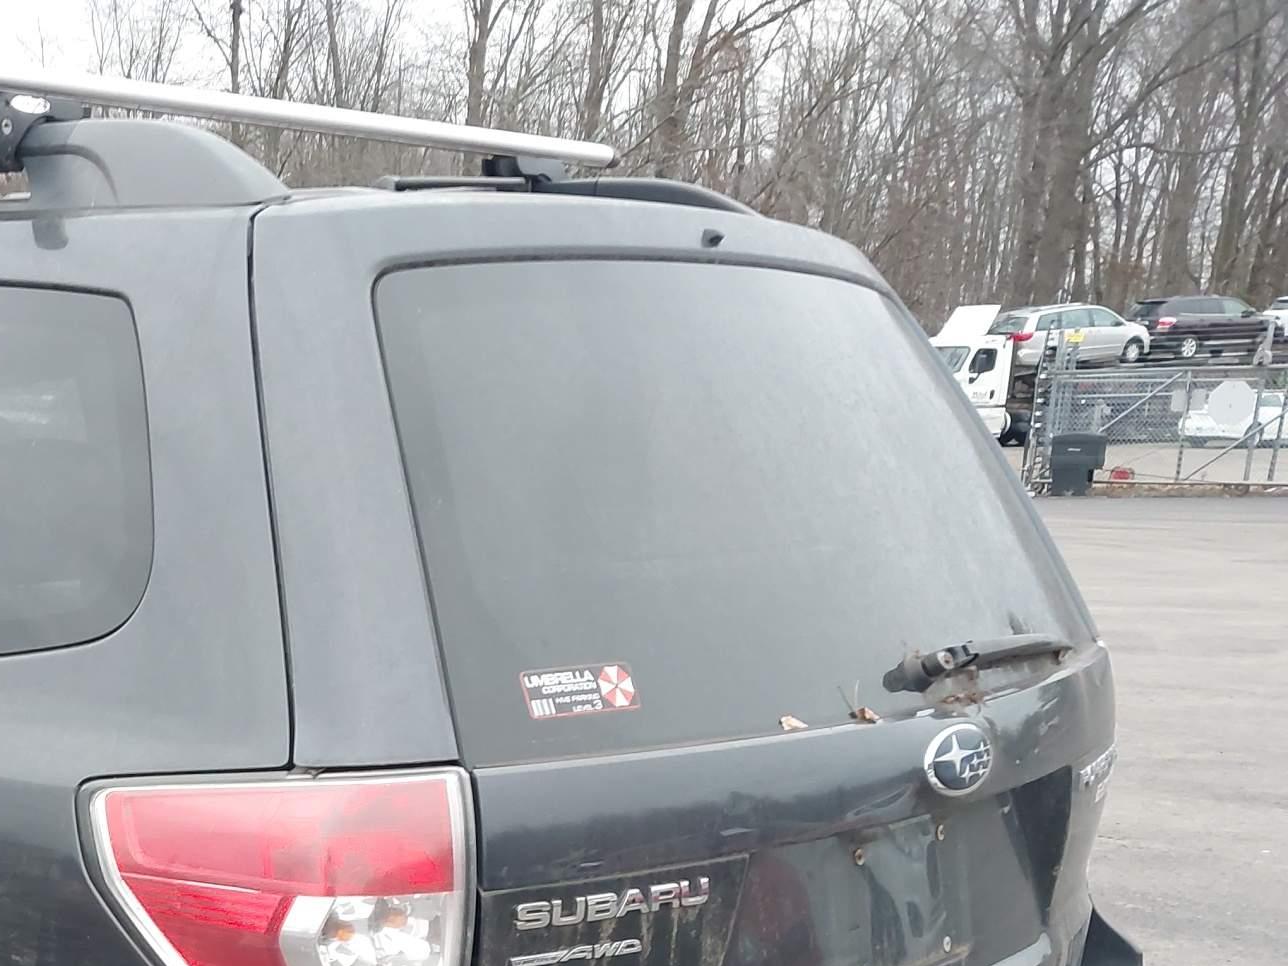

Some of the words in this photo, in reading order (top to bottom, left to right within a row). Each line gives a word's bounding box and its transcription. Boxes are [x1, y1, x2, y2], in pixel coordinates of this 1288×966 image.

[524, 670, 595, 688] UMBRELLA
[541, 682, 597, 694] CORPORATION
[514, 877, 710, 930] SUBARU
[559, 939, 643, 963] AWD
